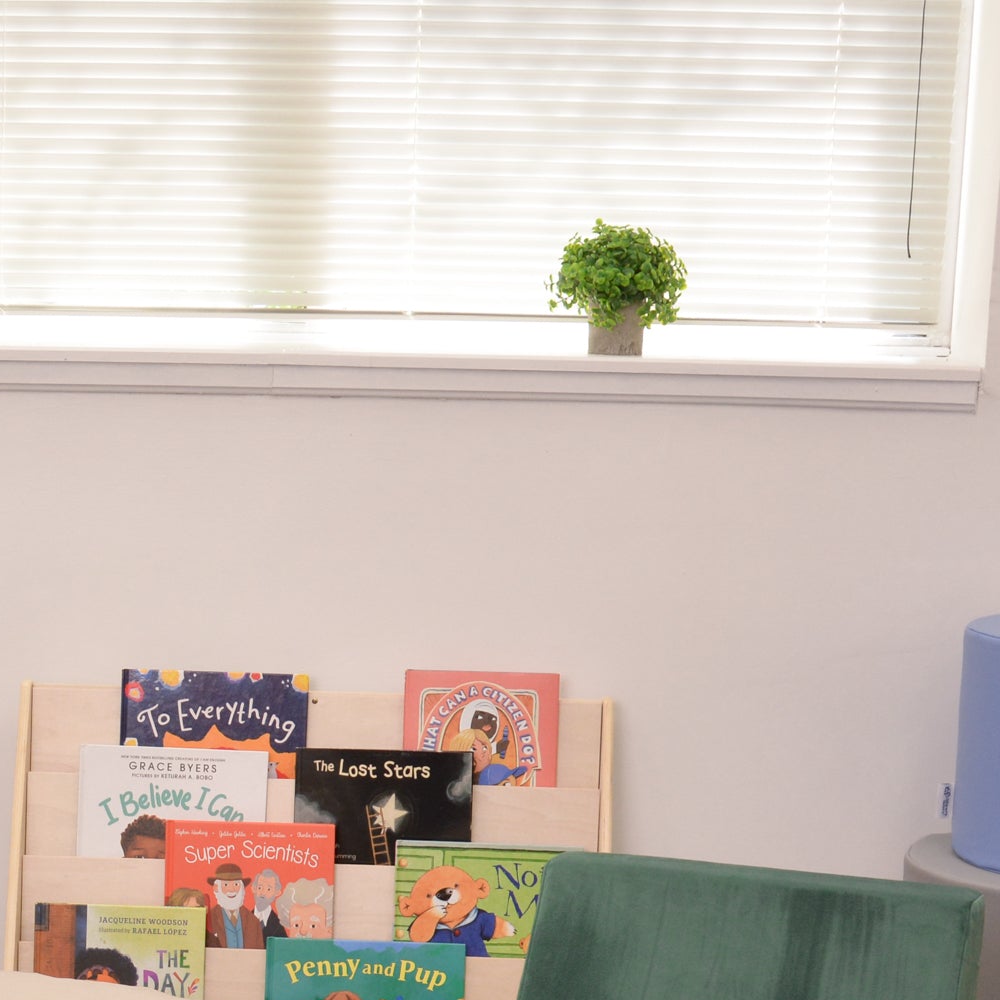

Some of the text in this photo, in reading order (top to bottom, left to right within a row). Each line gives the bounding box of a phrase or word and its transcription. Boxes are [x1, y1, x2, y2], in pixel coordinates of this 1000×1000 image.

[137, 698, 296, 744] To Everything
[439, 689, 467, 718] CAN
[469, 685, 479, 698] A
[482, 686, 529, 732] CITIZEN
[520, 734, 536, 765] DO?
[128, 761, 217, 773] GRACE BYERS
[313, 758, 431, 780] The Lost Stars
[98, 782, 245, 826] I Believe I Can
[184, 839, 319, 868] Super Scientists
[492, 862, 545, 890] No
[504, 890, 540, 919] M
[98, 916, 188, 926] JACQUELINE WOODSON
[156, 949, 190, 969] THE
[143, 969, 191, 998] DAY
[284, 958, 447, 991] Penny and Pup
